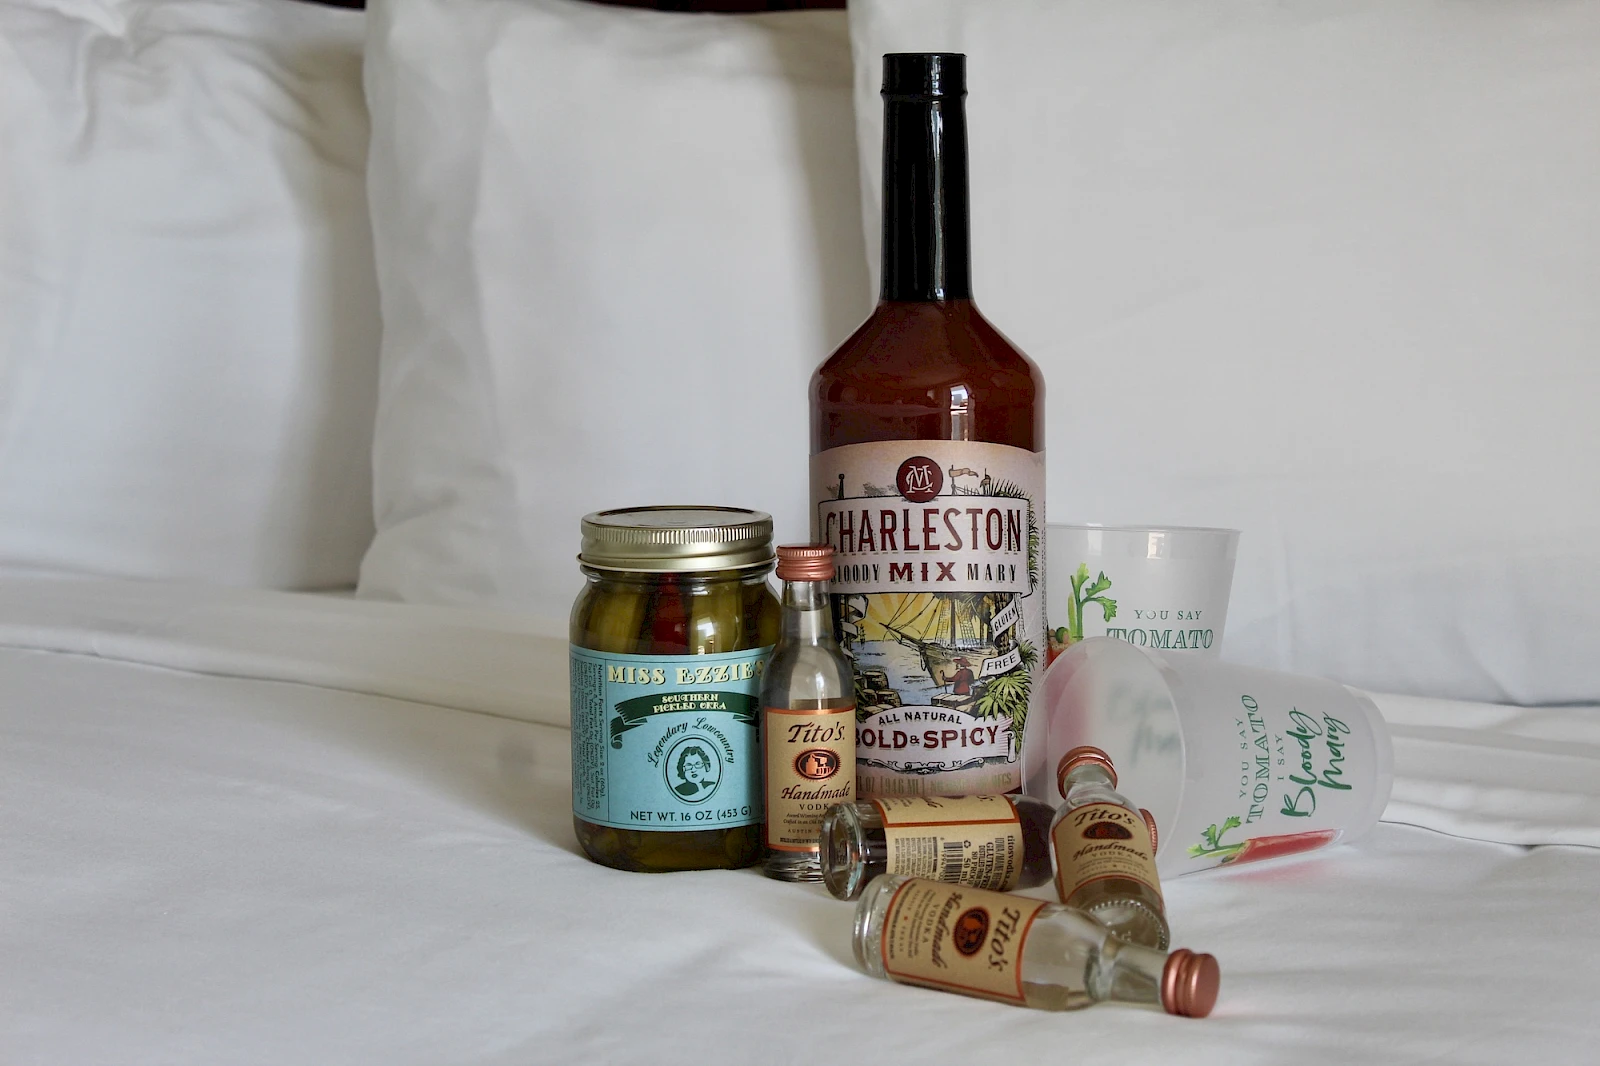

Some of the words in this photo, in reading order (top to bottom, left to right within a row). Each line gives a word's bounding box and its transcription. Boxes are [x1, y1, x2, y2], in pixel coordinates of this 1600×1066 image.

[826, 507, 1022, 553] CHARLESTON
[830, 562, 880, 584] LOODY
[889, 562, 956, 582] MIX
[967, 563, 1017, 582] MARY
[994, 607, 1016, 632] GLUTEN
[1134, 609, 1169, 620] YOU
[1177, 610, 1203, 620] SAY
[1106, 627, 1214, 650] TOMATO
[607, 665, 666, 686] MISS
[676, 660, 765, 686] EZZIE'S
[986, 653, 1017, 671] FREE
[652, 702, 696, 714] PICKLED
[700, 702, 726, 710] OKRA
[662, 693, 718, 703] SOUTHERN
[878, 714, 900, 726] ALL
[904, 711, 962, 725] NATURAL
[647, 720, 688, 768] Legendary
[692, 717, 736, 764] Lowcountry
[923, 725, 998, 749] SPICY
[1234, 718, 1248, 750] SAY
[1241, 694, 1270, 824] TOMATO
[1275, 734, 1285, 766] SAY
[1318, 711, 1352, 790] Mary
[1280, 706, 1323, 818] Bloody
[781, 781, 850, 800] Handmade
[1239, 761, 1250, 800] YOU
[630, 810, 653, 822] NET
[657, 812, 677, 822] WT.
[680, 812, 691, 822] 16
[695, 810, 713, 821] OZ
[716, 808, 738, 820] (453
[964, 858, 971, 868] 50
[971, 851, 978, 860] 80
[1072, 841, 1148, 862] Handmade
[960, 871, 968, 884] mL
[921, 903, 940, 944] VODKA
[932, 892, 964, 970] Handmade
